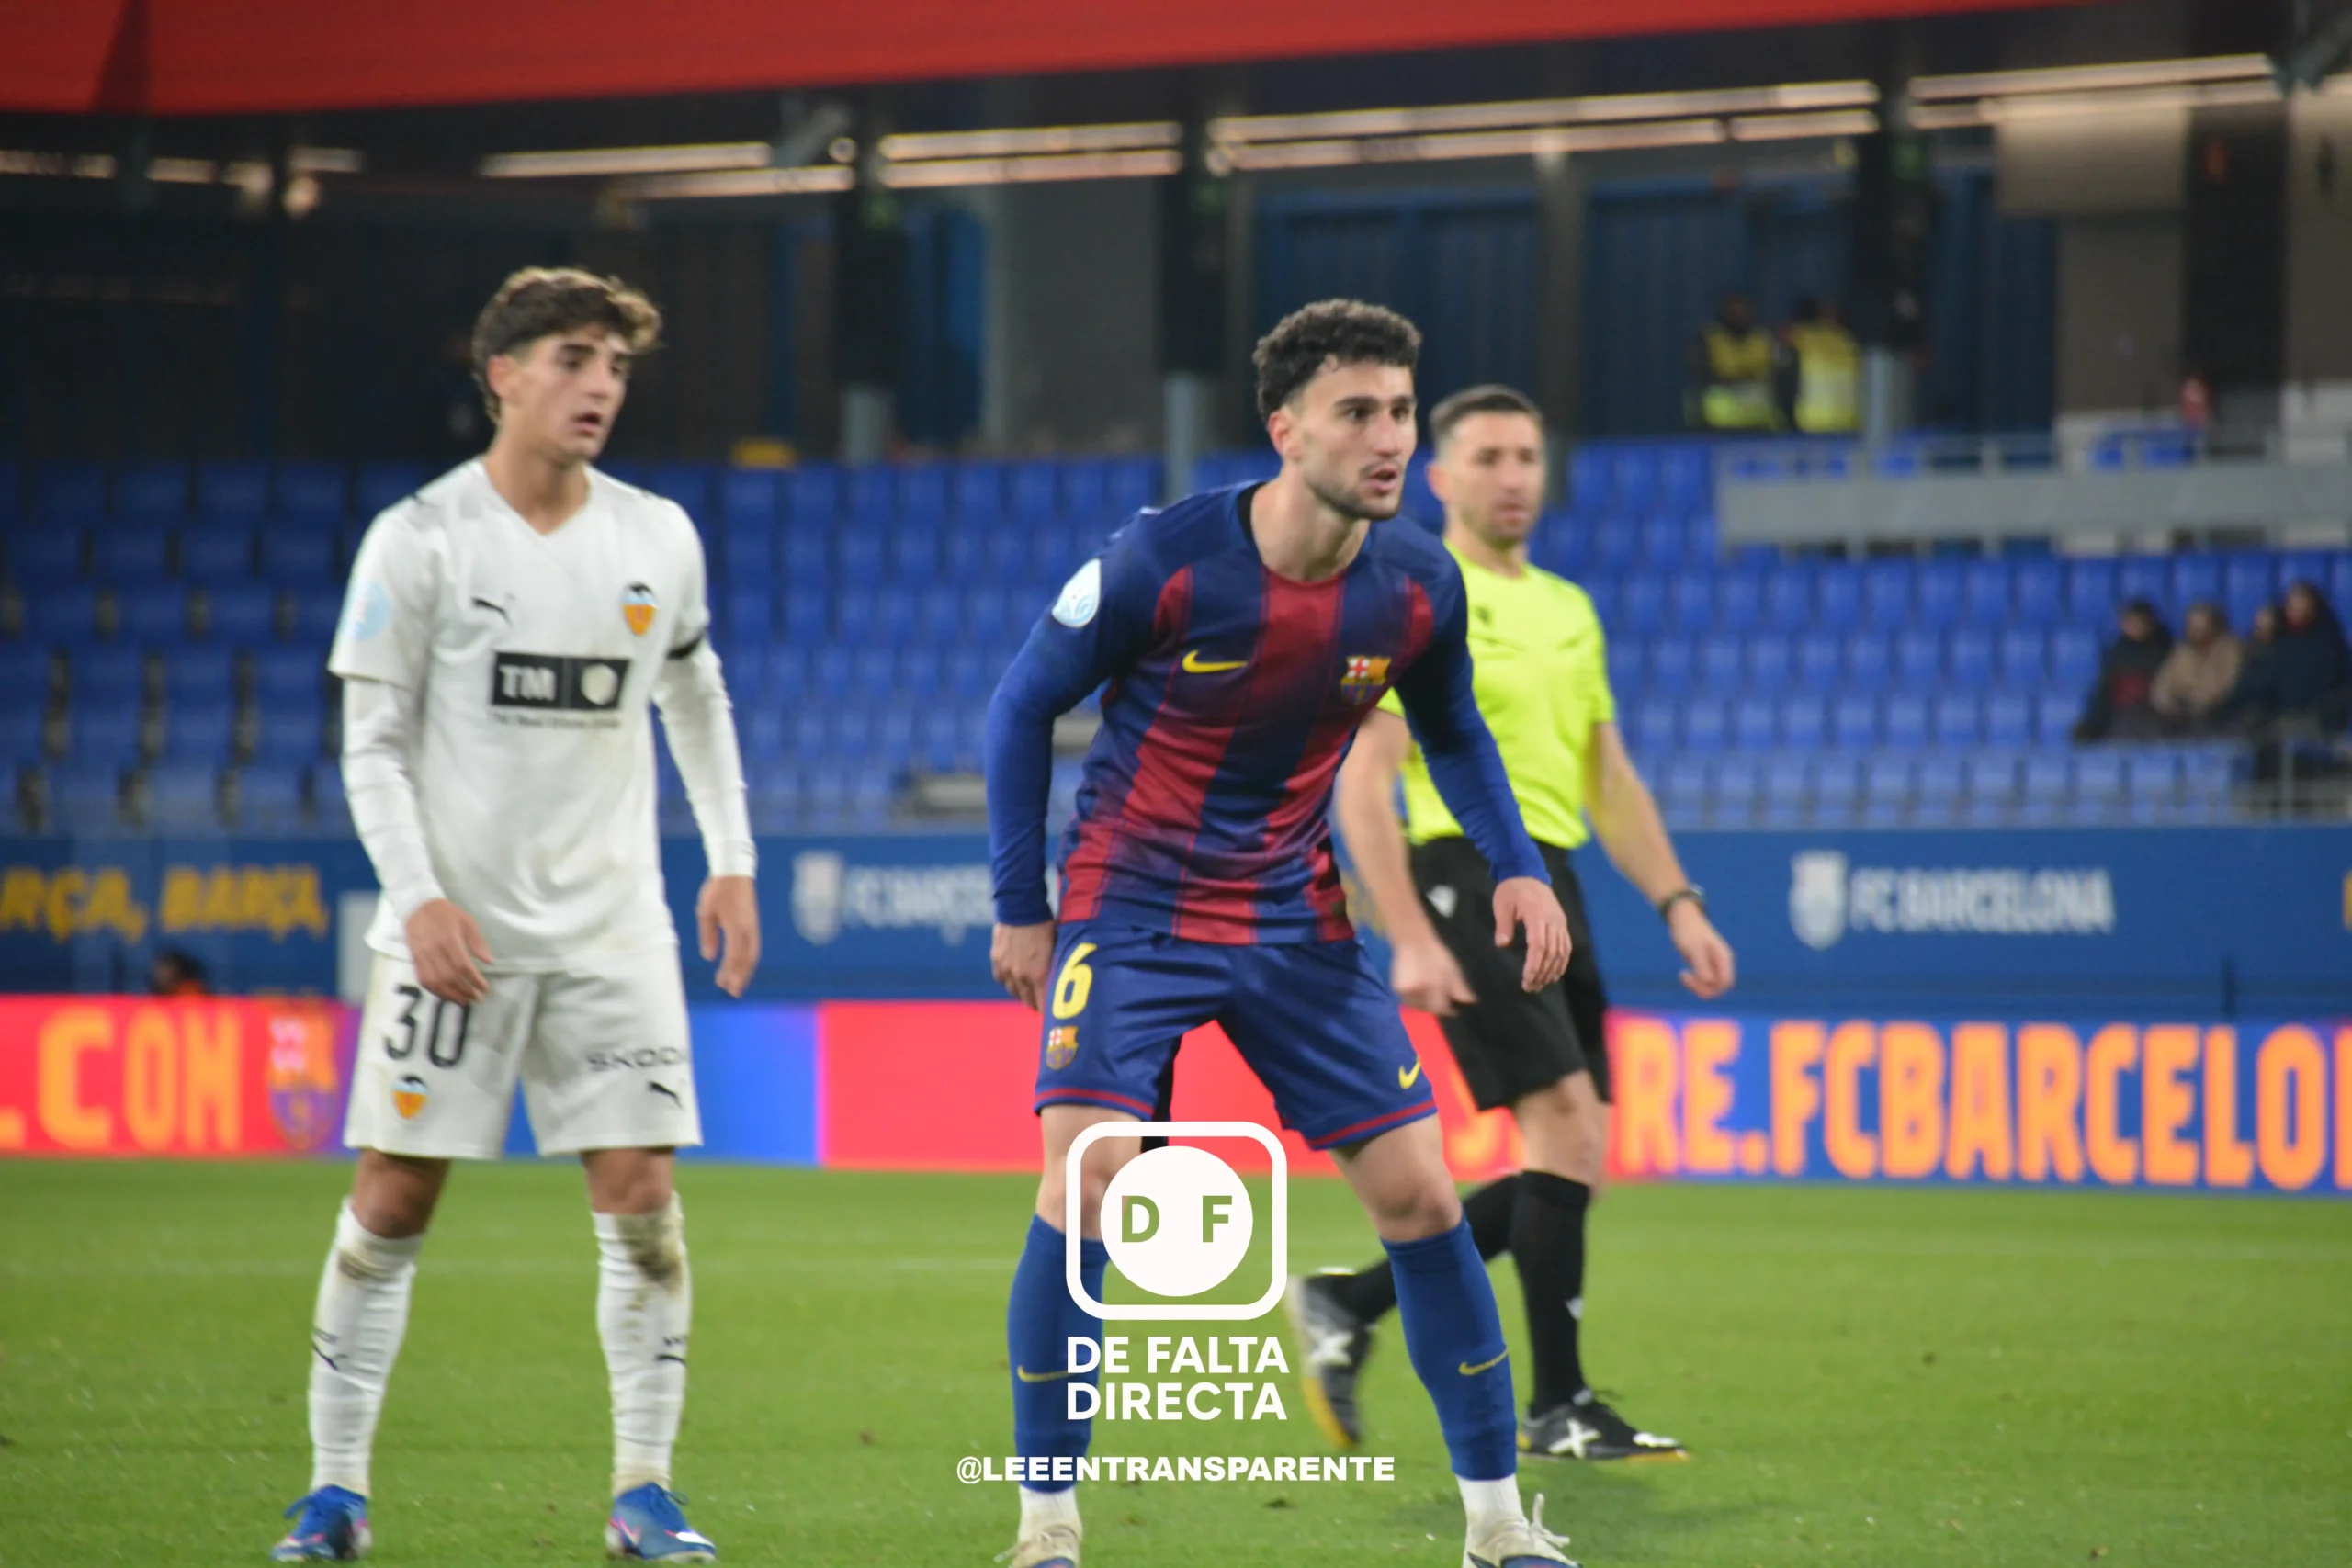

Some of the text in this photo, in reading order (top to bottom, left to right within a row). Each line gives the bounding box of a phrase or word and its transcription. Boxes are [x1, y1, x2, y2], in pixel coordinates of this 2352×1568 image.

[499, 664, 557, 702] TM
[1849, 866, 2117, 934] FC BARCELONA
[1052, 942, 1097, 1021] 6
[384, 983, 472, 1069] 30
[1447, 1018, 2352, 1192] RE.FCBARCELO
